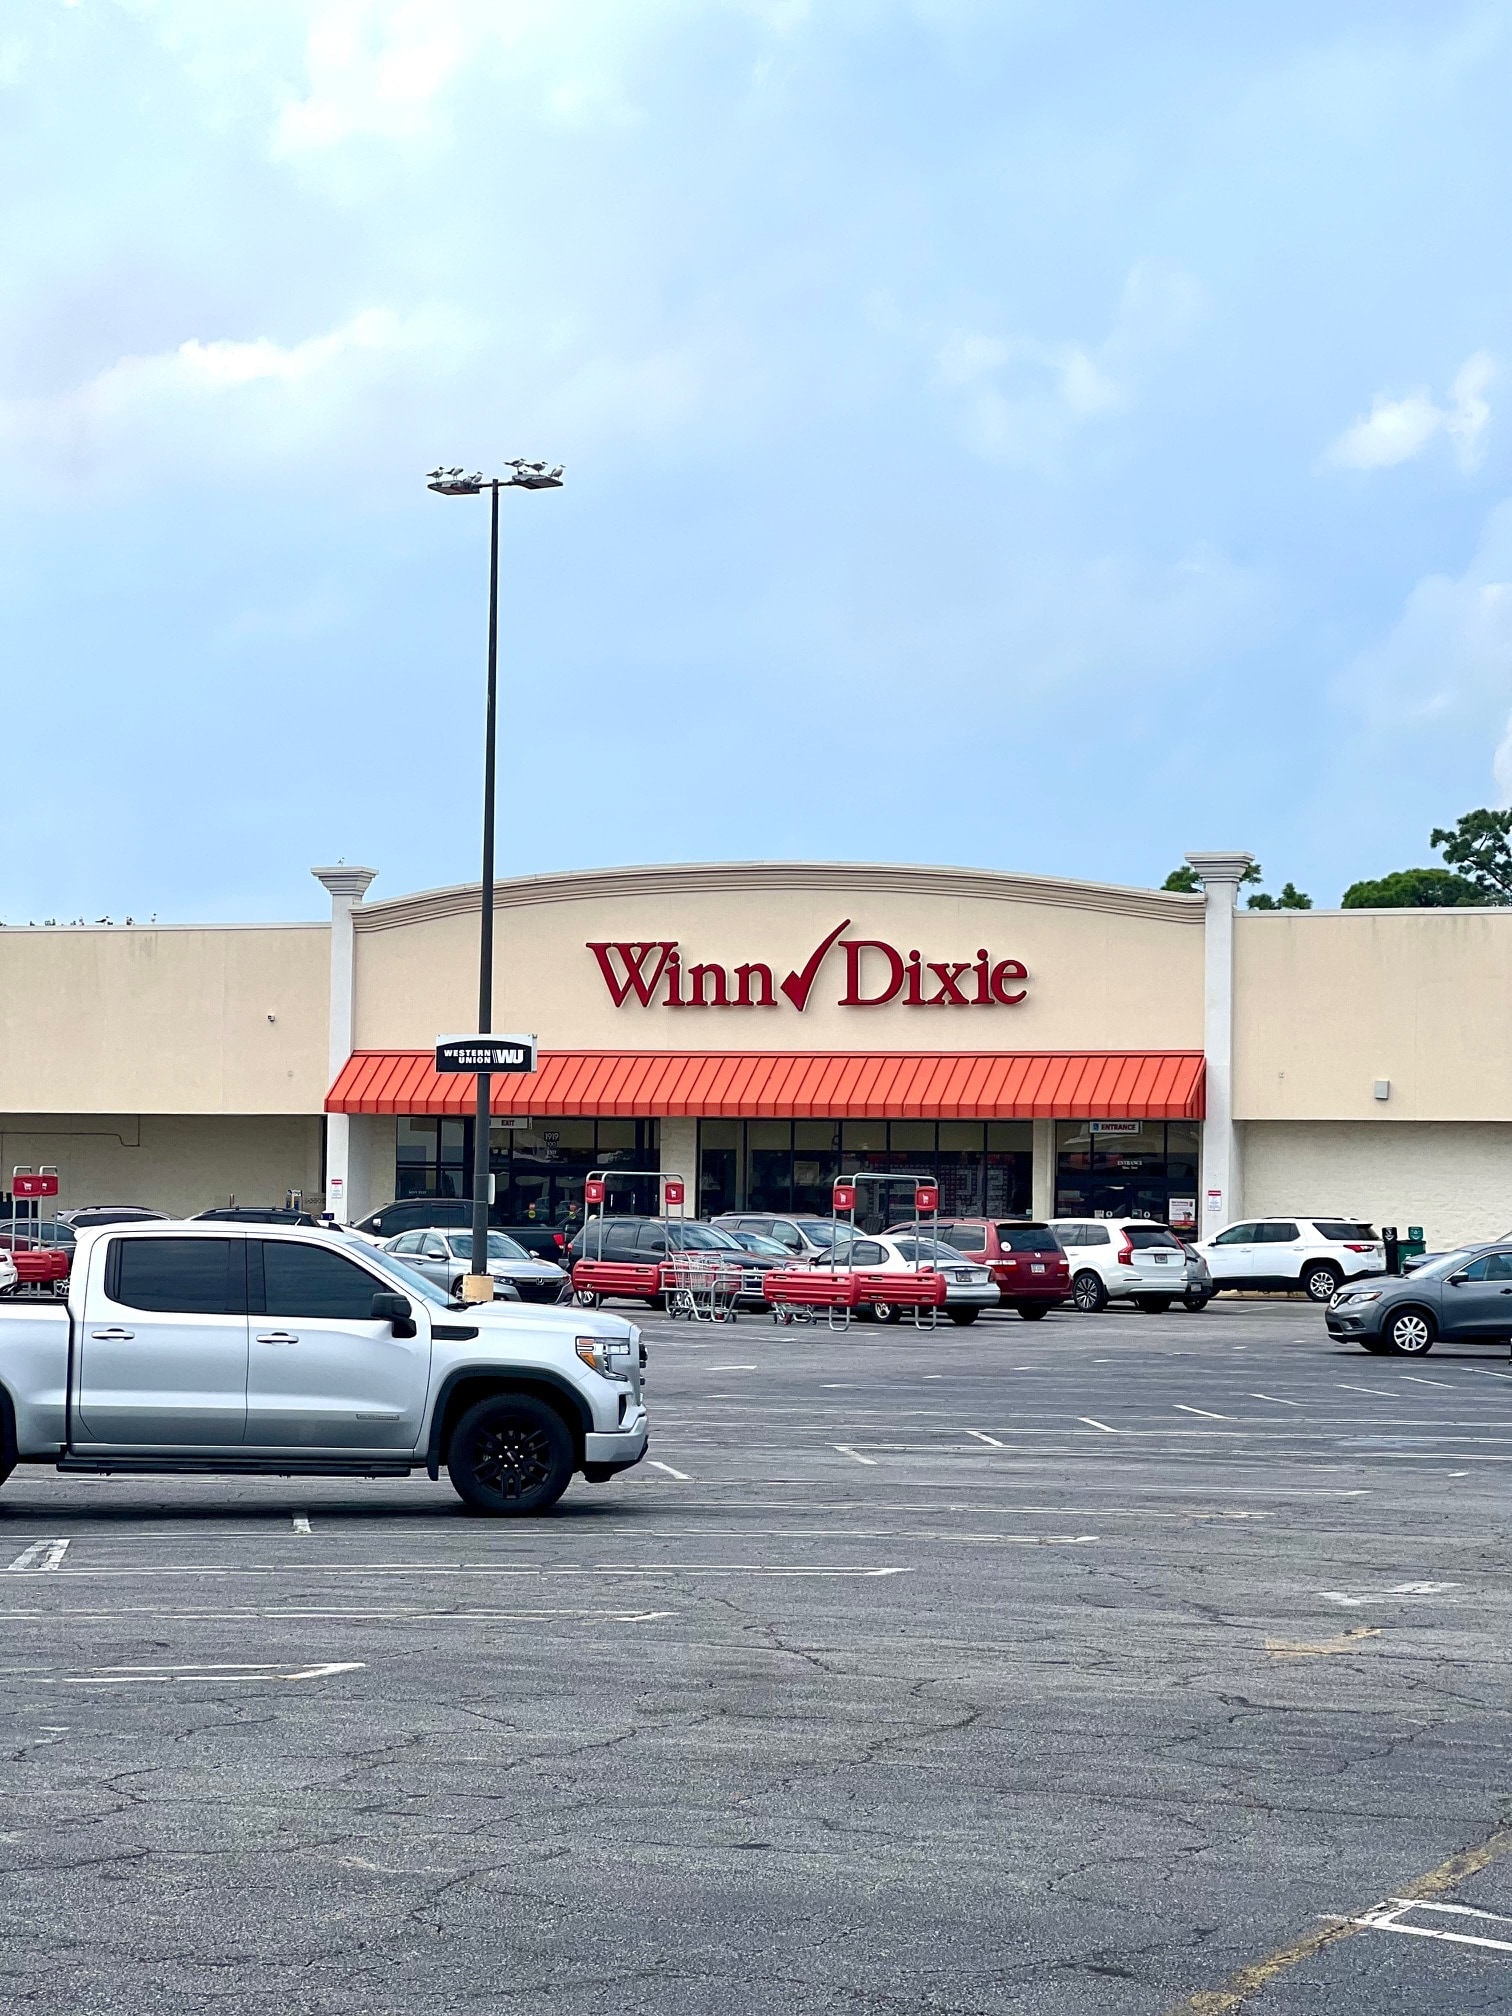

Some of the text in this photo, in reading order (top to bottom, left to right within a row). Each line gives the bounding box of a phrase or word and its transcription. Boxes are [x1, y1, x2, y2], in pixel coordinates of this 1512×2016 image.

[585, 940, 1029, 1009] Winn Dixie
[443, 1049, 491, 1057] WESTERN
[496, 1049, 524, 1064] WU
[458, 1056, 491, 1064] UNION
[1101, 1123, 1136, 1131] ENTRANCE
[545, 1132, 559, 1141] 1919
